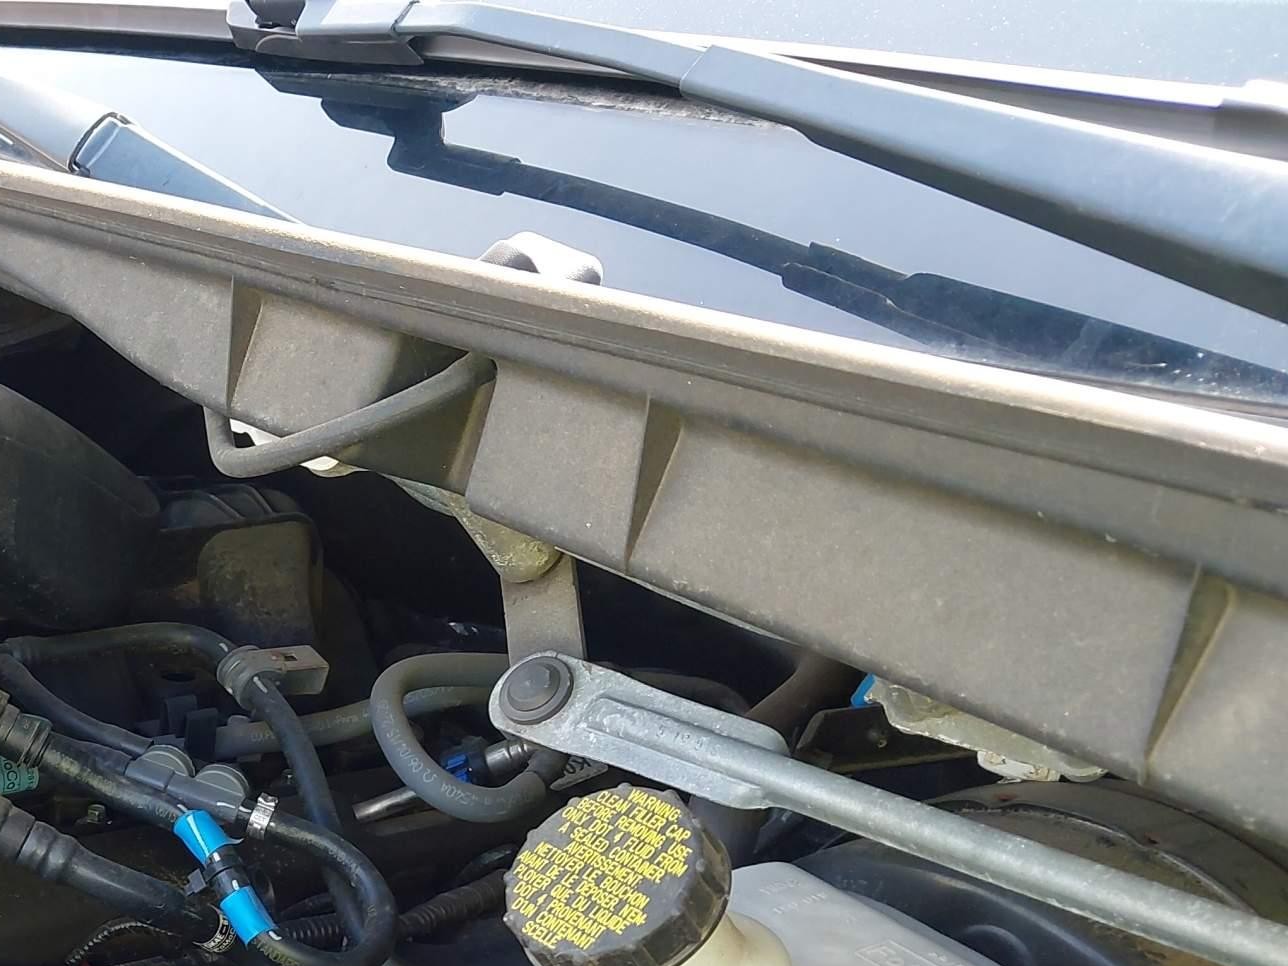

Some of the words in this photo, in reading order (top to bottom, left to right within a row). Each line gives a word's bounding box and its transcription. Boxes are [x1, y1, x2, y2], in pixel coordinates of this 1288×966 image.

[576, 797, 617, 823] BEFORE
[666, 842, 692, 863] USE
[596, 790, 633, 814] CLEAN
[628, 804, 667, 832] FILLER
[665, 823, 692, 845] CAP
[627, 789, 681, 825] WARNING:
[559, 822, 572, 833] A
[570, 829, 611, 854] SEALED
[562, 806, 592, 827] ONLY
[587, 819, 616, 839] DOT
[623, 838, 658, 861] FLUID
[653, 853, 688, 877] FROM
[517, 852, 549, 873] AVANT
[544, 866, 563, 881] DE
[559, 874, 578, 888] LE
[533, 843, 585, 874] NETTOYER
[582, 868, 602, 883] LE
[599, 877, 649, 911] BOUCHON
[562, 842, 645, 891] AVERTISSEMENT:
[511, 898, 539, 919] D'UN
[534, 911, 595, 950] CONTENANT
[513, 882, 539, 901] DOT
[546, 900, 607, 939] PROVENANT
[514, 865, 552, 891] PLOYER
[549, 884, 575, 903] QUE
[572, 897, 592, 912] DU
[589, 906, 631, 934] LIQUIDE
